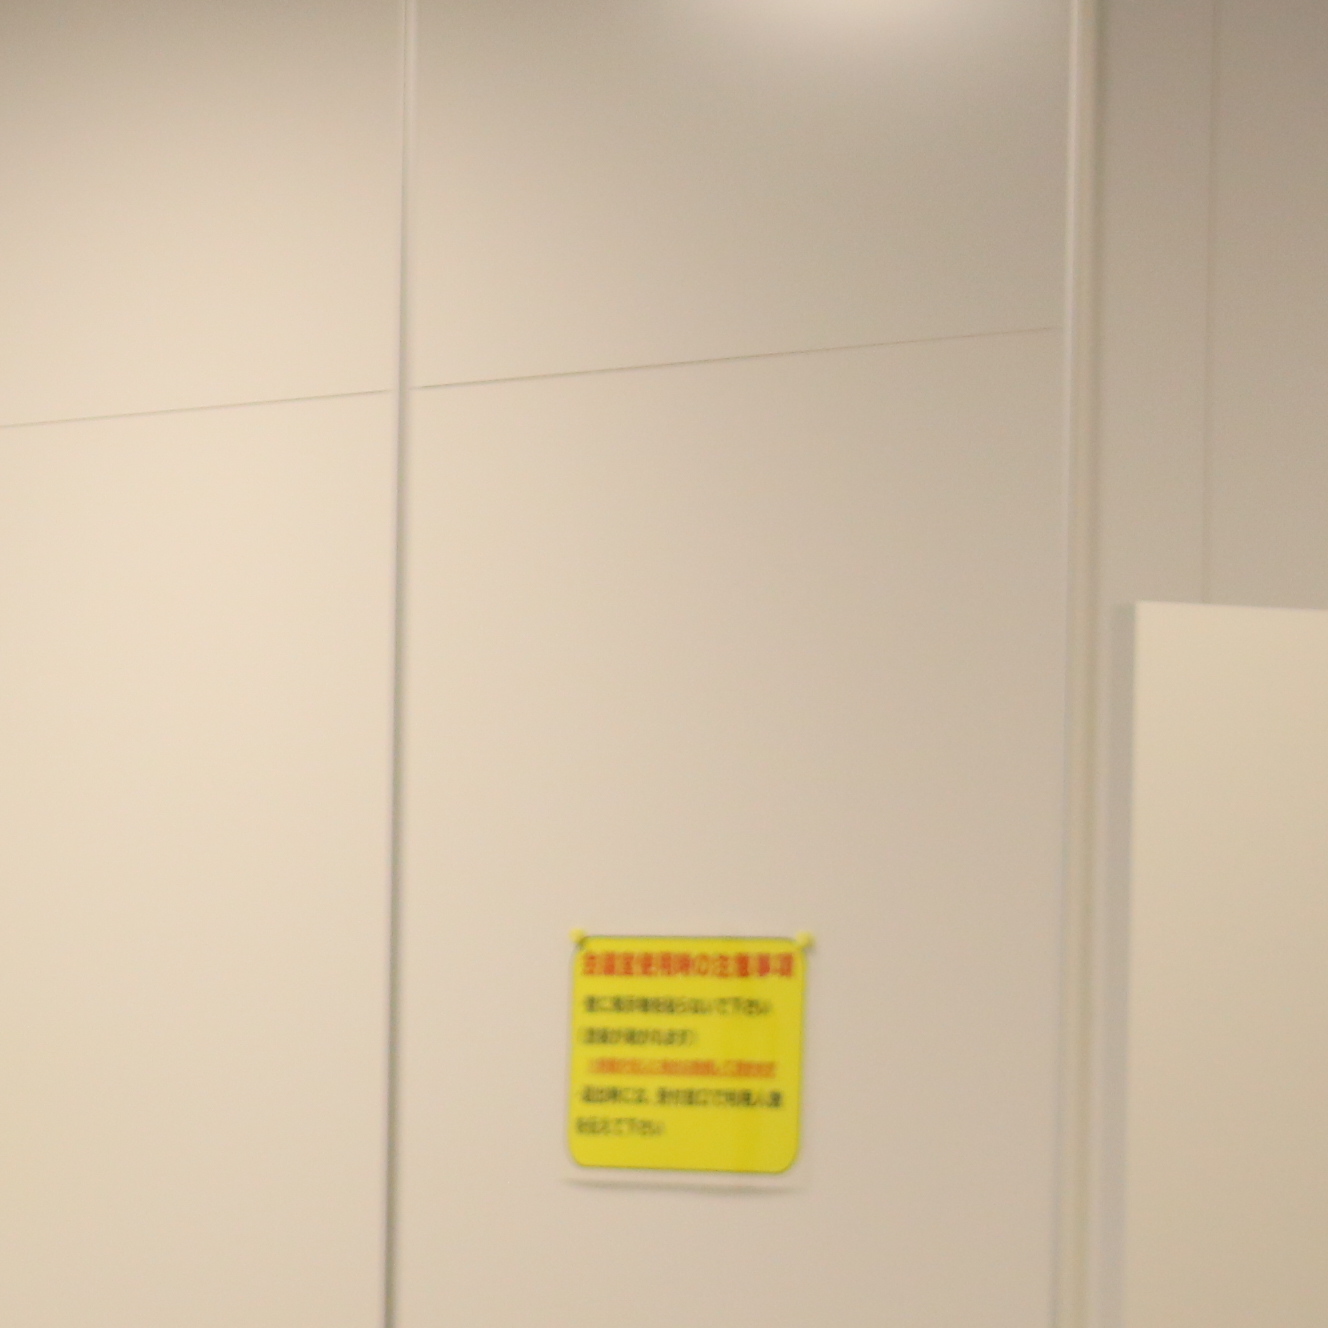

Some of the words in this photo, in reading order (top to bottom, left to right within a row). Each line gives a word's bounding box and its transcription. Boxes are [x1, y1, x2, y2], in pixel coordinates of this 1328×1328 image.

[584, 952, 794, 978] 会議室使用時の注意事項
